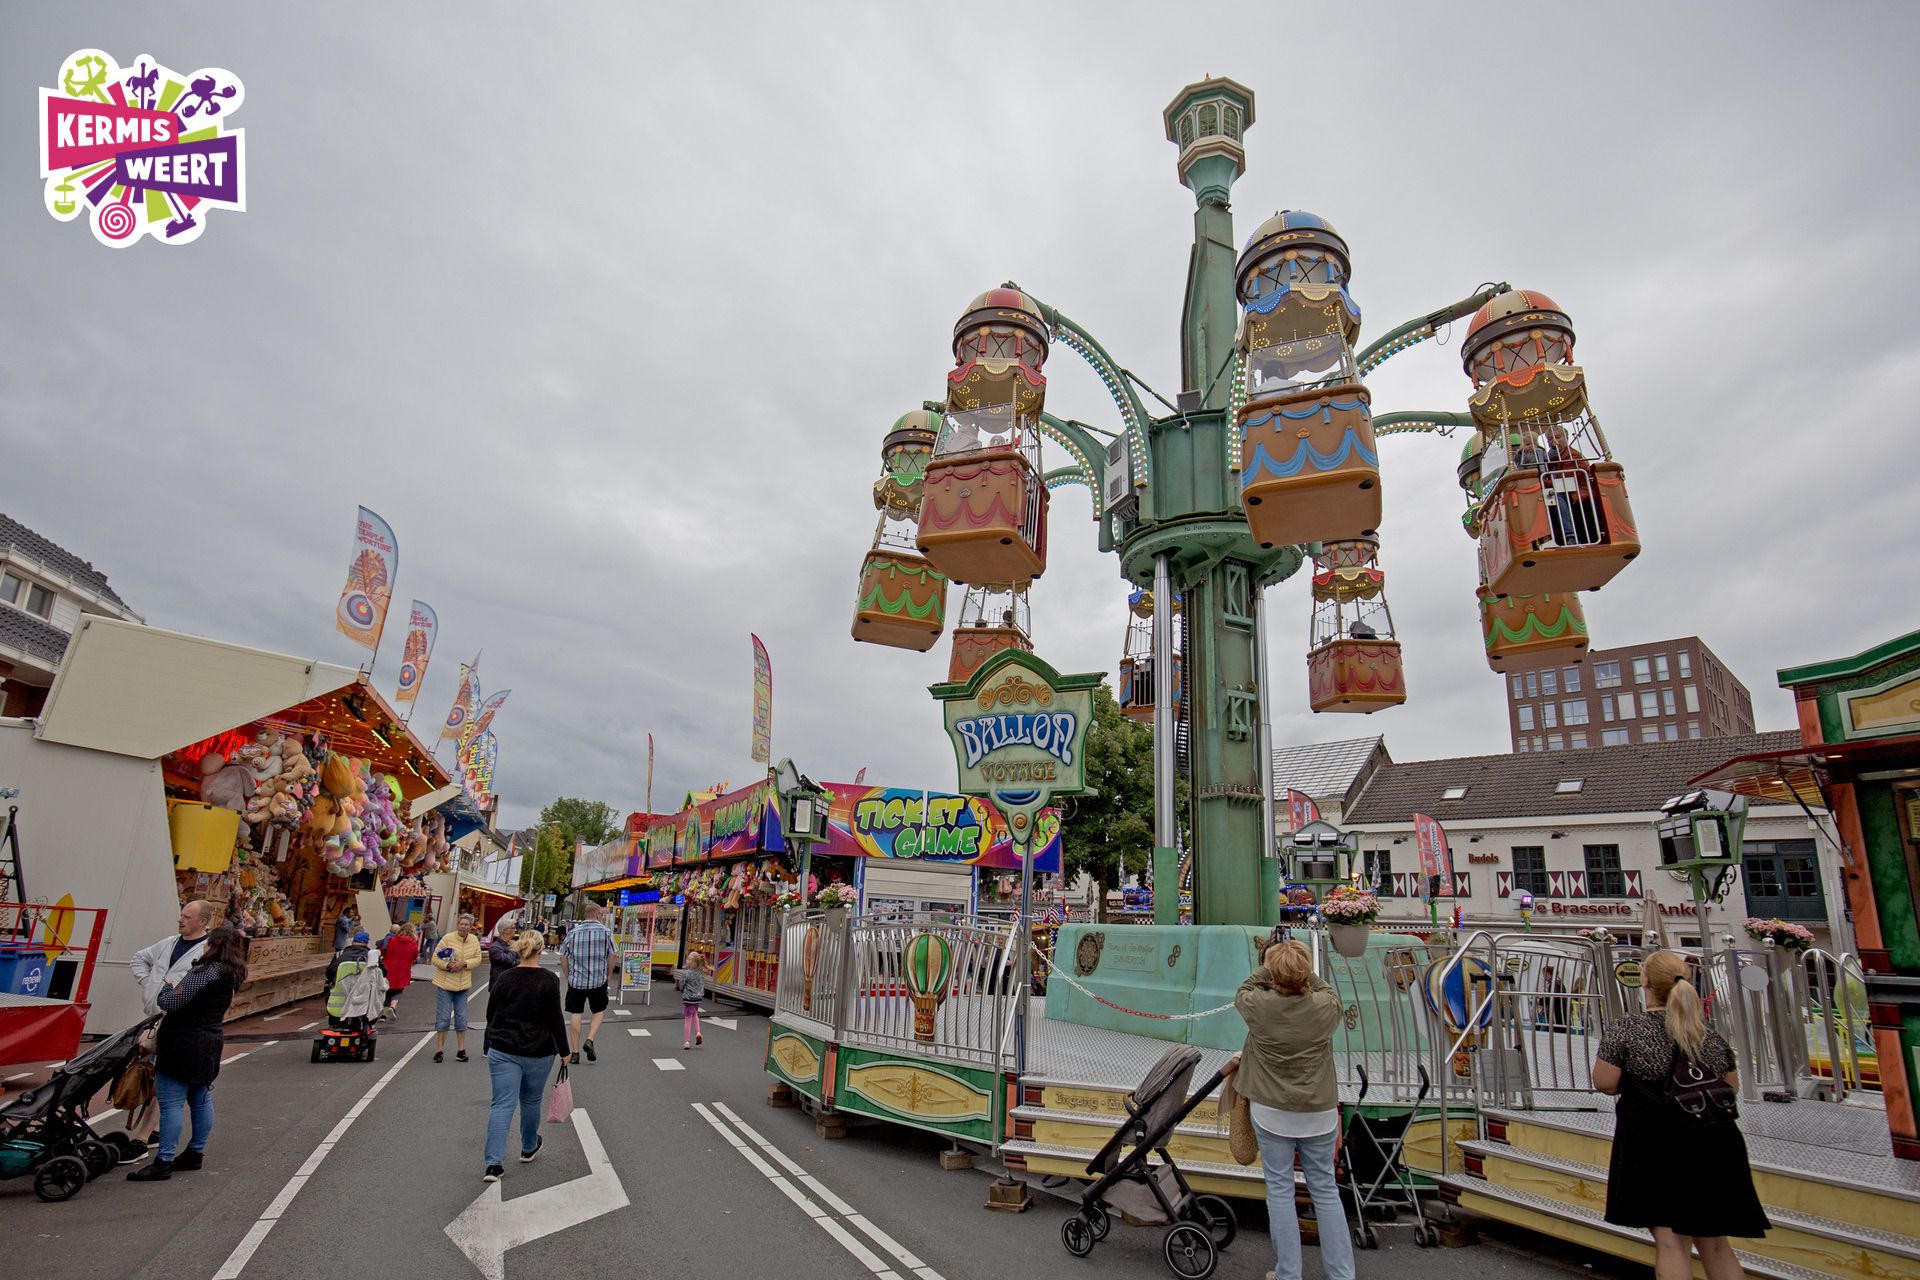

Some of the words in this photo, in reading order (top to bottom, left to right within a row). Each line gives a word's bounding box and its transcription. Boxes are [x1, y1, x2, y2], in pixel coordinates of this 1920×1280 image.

[956, 712, 1076, 769] BALLON
[981, 760, 1057, 783] VOYAGE
[856, 799, 965, 830] TICKET
[895, 826, 980, 859] GAME
[1551, 902, 1632, 915] Brasserie
